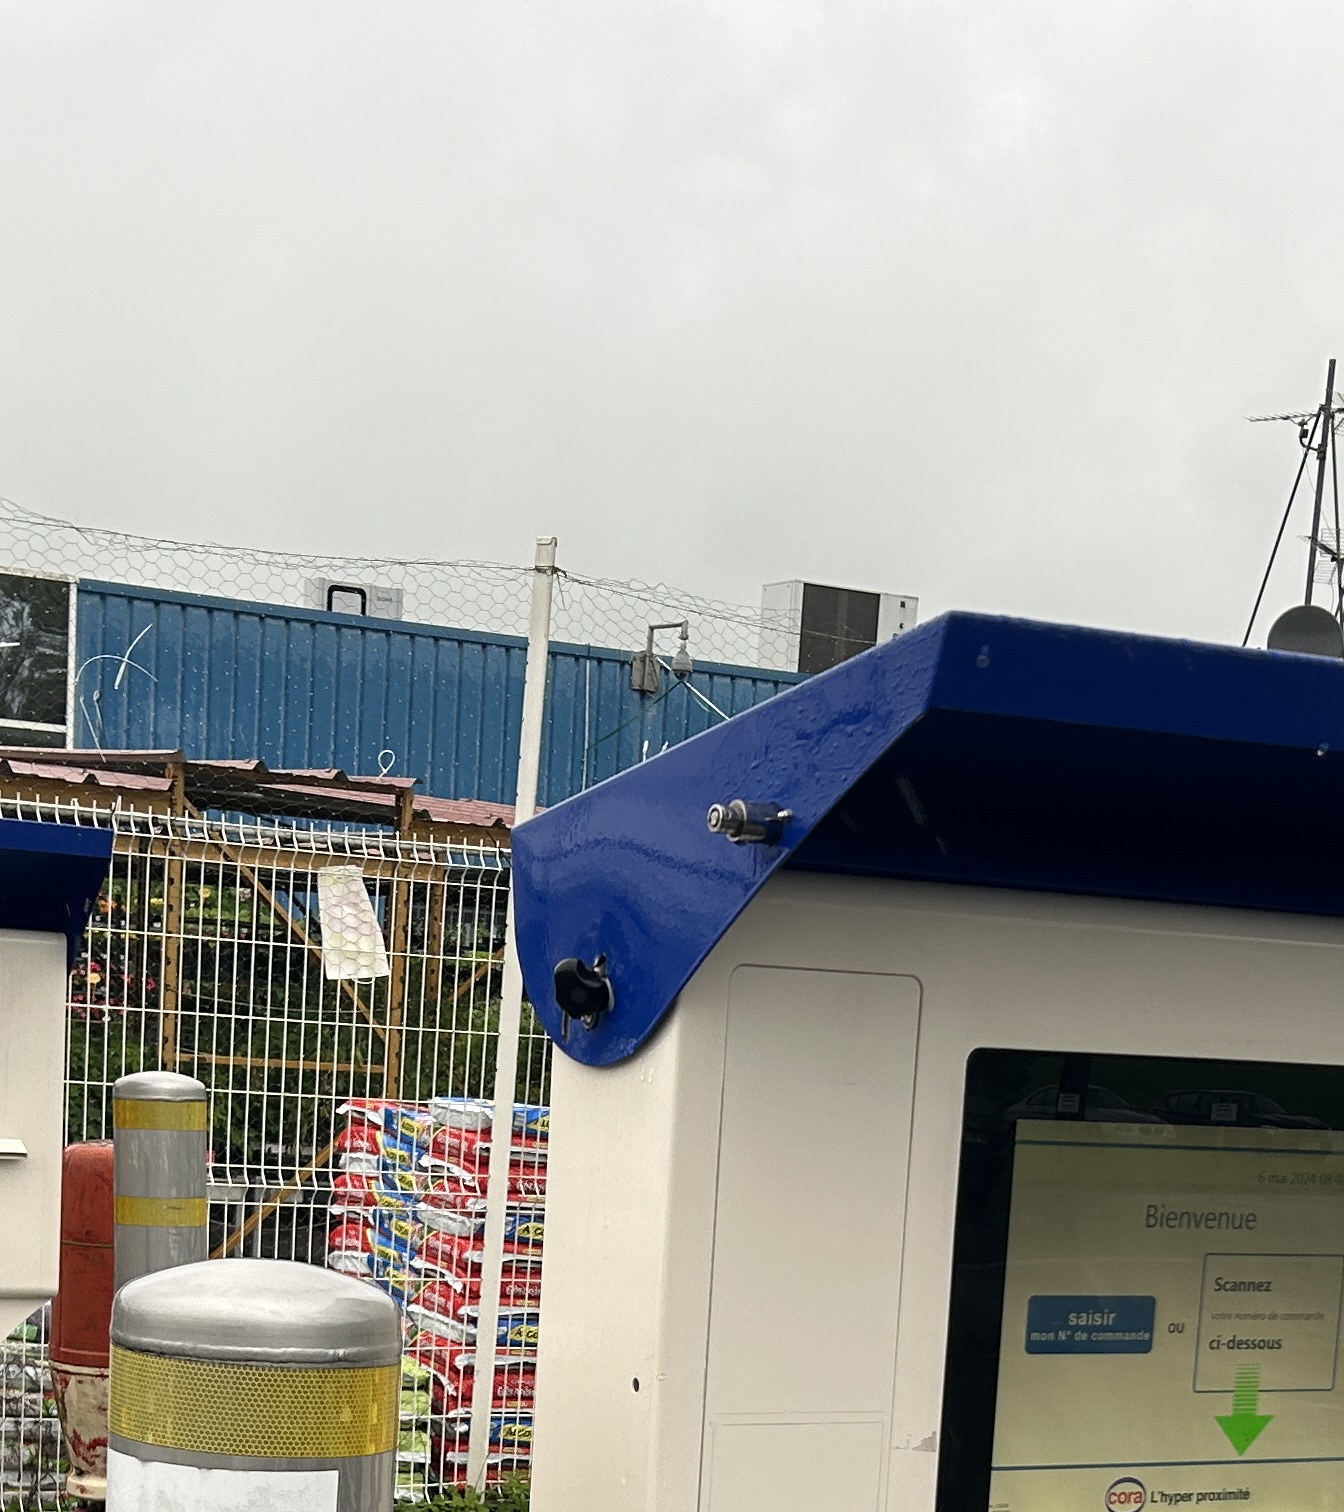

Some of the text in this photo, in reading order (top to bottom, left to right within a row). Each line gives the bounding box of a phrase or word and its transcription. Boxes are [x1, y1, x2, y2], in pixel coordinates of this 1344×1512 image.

[1258, 1173, 1266, 1184] 6
[1268, 1173, 1288, 1184] mai
[1290, 1172, 1317, 1185] 2024
[1145, 1204, 1258, 1230] Bienvenue
[1213, 1276, 1272, 1292] Scannez
[1068, 1309, 1116, 1326] saisir
[1030, 1332, 1055, 1341] mon
[1074, 1330, 1087, 1341] de
[1090, 1330, 1150, 1341] commande
[1167, 1322, 1185, 1334] ou
[1208, 1334, 1282, 1350] ci-dessous
[1107, 1490, 1143, 1505] cora
[1150, 1487, 1250, 1505] L'hyper proximité
